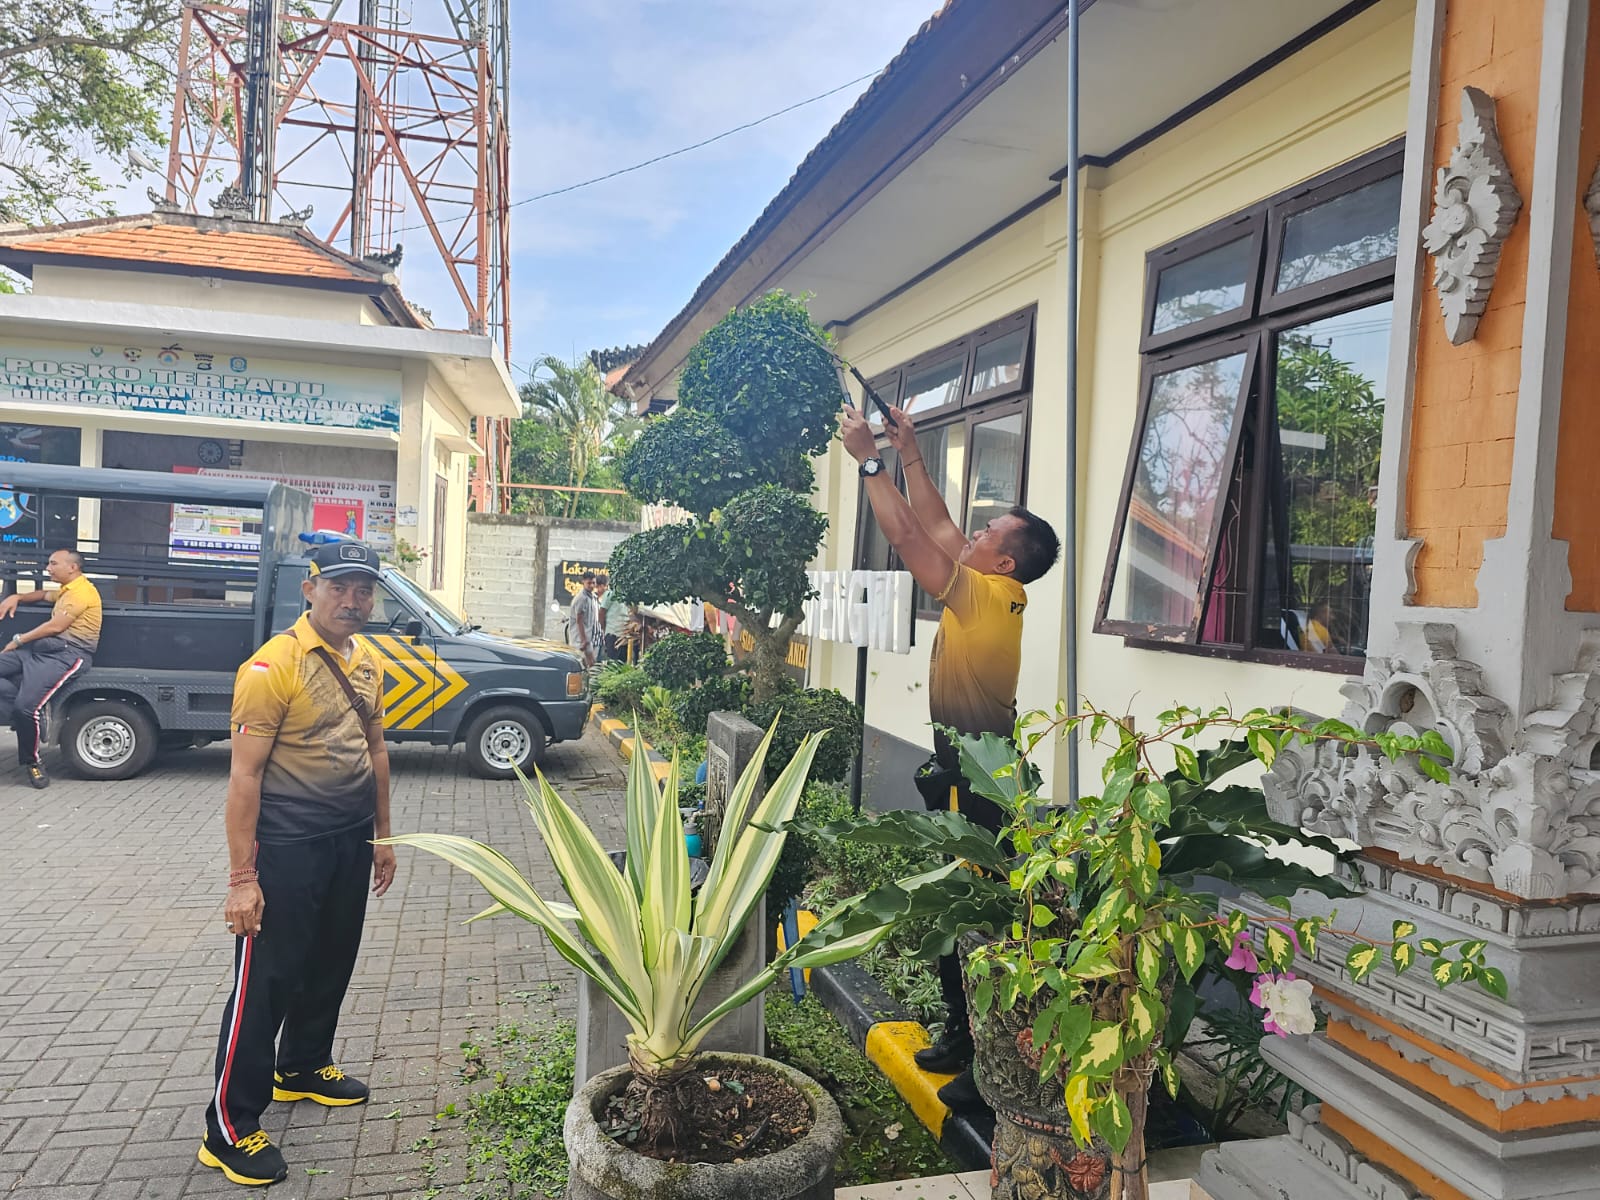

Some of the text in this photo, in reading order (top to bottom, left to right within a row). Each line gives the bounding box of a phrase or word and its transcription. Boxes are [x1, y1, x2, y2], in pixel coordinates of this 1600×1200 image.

[5, 357, 325, 397] POSKO TERPADU
[50, 390, 203, 413] KECAMATAN
[209, 402, 320, 421] MENGWI
[191, 388, 309, 409] BENCANA
[314, 400, 383, 414] ALAM
[183, 540, 261, 551] TUGAS POKO
